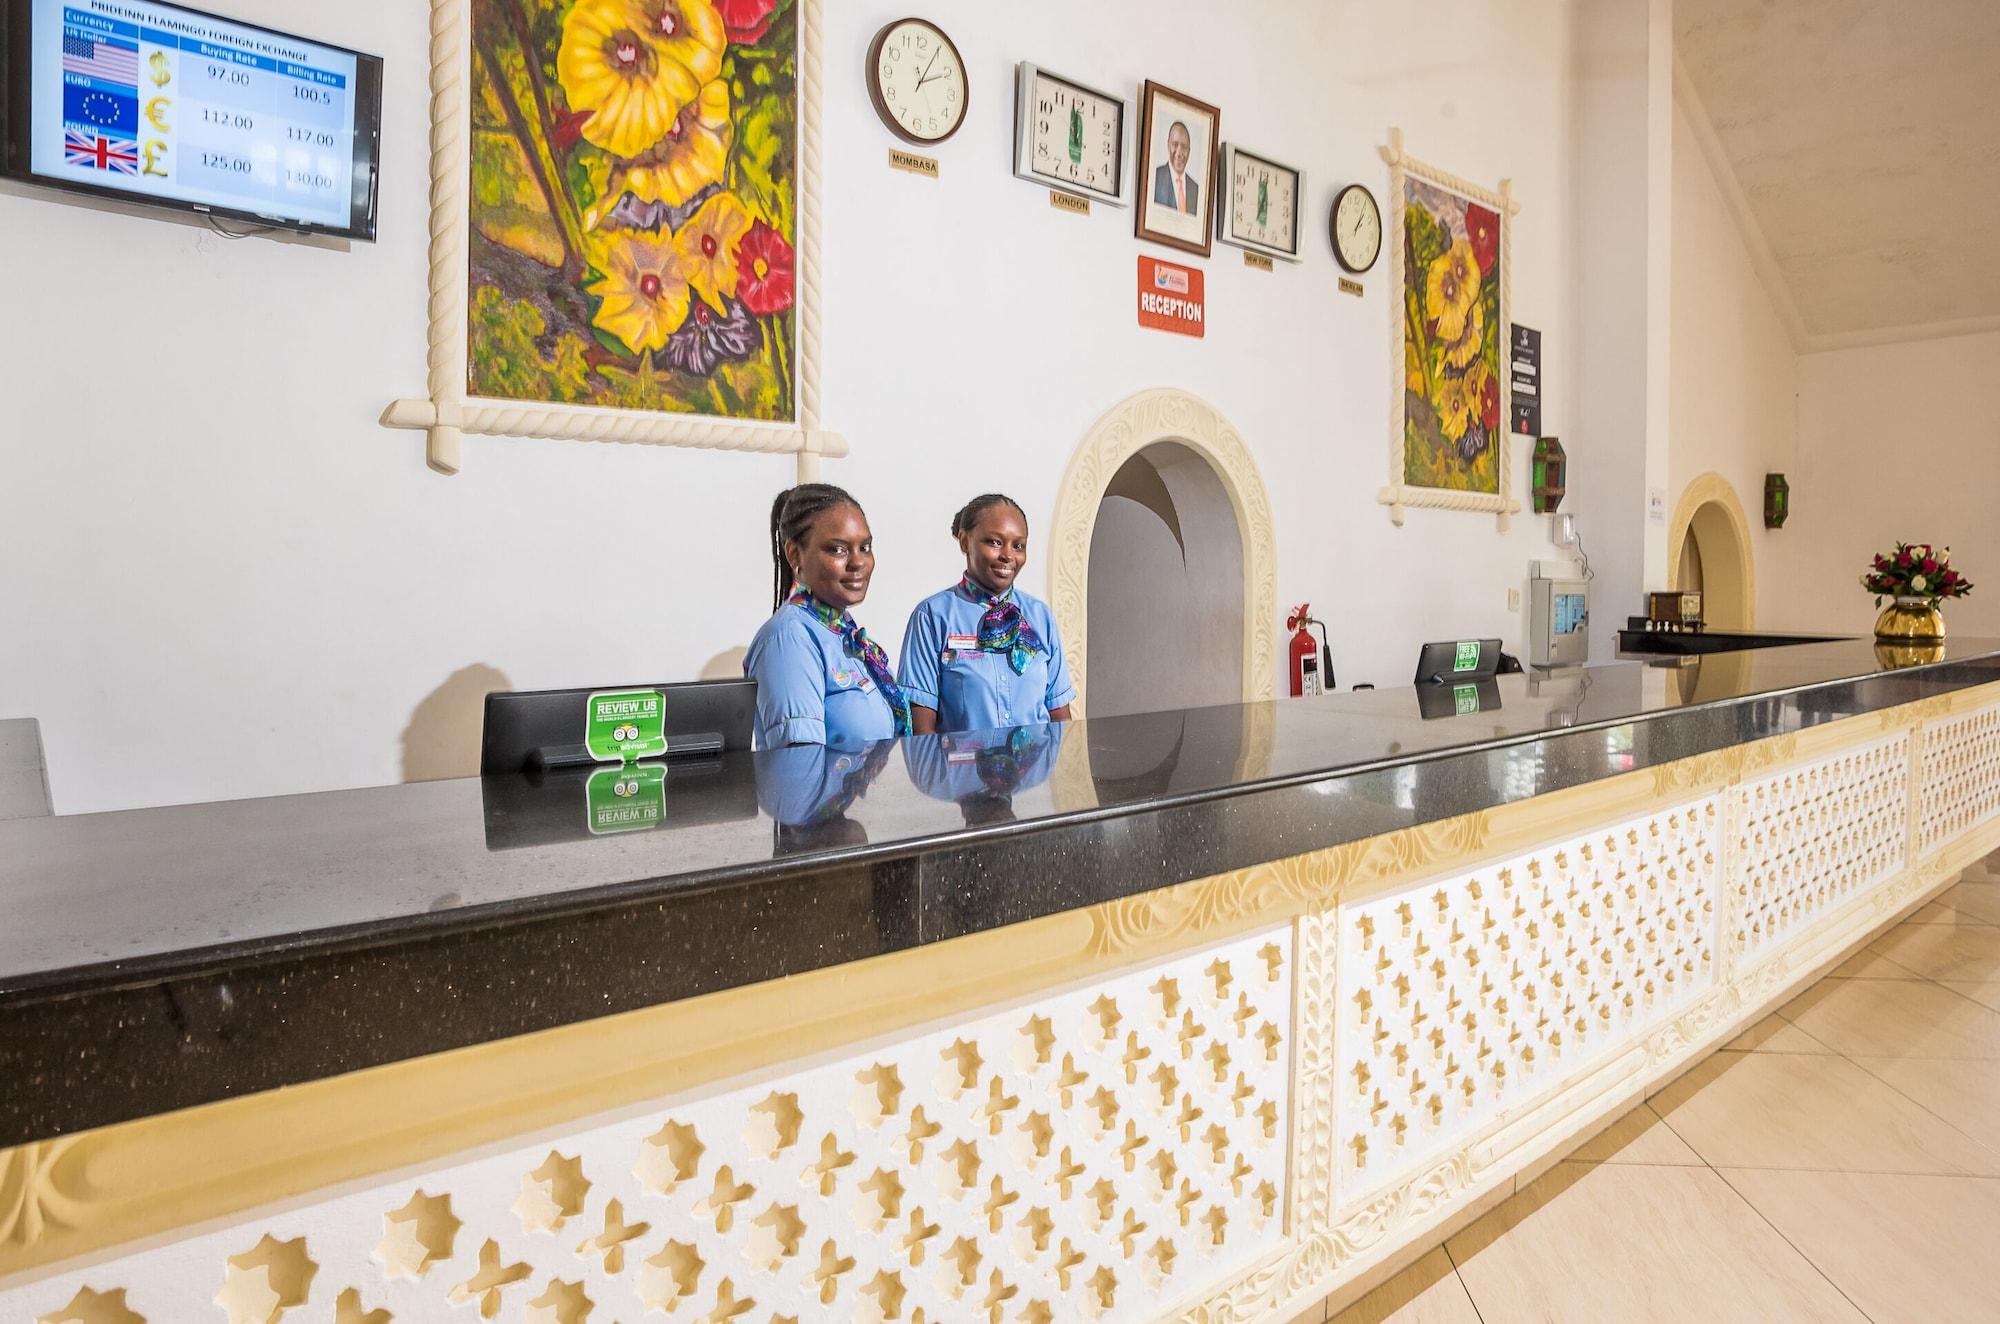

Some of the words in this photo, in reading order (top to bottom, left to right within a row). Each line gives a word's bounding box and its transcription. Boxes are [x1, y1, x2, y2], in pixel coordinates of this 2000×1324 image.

[66, 10, 114, 33] Currency
[91, 0, 145, 21] PRIDEINN
[148, 14, 206, 36] FLAMINGO
[209, 31, 254, 49] FOREIGN
[256, 41, 308, 62] EXCHANGE
[902, 35, 911, 49] 11
[916, 35, 928, 48] 12
[200, 43, 233, 63] Buying
[235, 52, 257, 66] Rate
[888, 45, 901, 62] 10
[207, 63, 250, 87] 97.00
[316, 71, 337, 84] Rate
[883, 65, 893, 79] 9
[943, 66, 952, 80] 2
[65, 73, 92, 88] EURO
[293, 85, 331, 105] 100.5
[886, 88, 896, 102] 8
[947, 88, 956, 102] 3
[1055, 91, 1064, 107] 11
[899, 107, 908, 121] 7
[941, 107, 949, 120] 4
[1040, 100, 1053, 116] 10
[203, 108, 253, 130] 112.00
[912, 118, 922, 132] 6
[928, 117, 938, 131] 5
[65, 120, 99, 135] POUND
[1040, 120, 1049, 135] 9
[1103, 121, 1111, 136] 2
[288, 126, 334, 148] 117.00
[1038, 143, 1049, 158] 8
[1103, 141, 1111, 157] 3
[202, 153, 252, 174] 125.00
[891, 153, 937, 173] MOMBASA
[1054, 157, 1062, 173] 7
[1101, 163, 1108, 177] 4
[1069, 164, 1078, 178] 6
[1086, 168, 1095, 183] 5
[287, 169, 333, 189] 130.00
[1053, 194, 1089, 211] LONDON
[1245, 254, 1258, 264] NEW
[1258, 257, 1272, 267] YORK
[1341, 278, 1363, 293] BERLIN
[1141, 291, 1202, 323] RECEPTION
[597, 700, 640, 715] REVIEW
[643, 699, 657, 711] US
